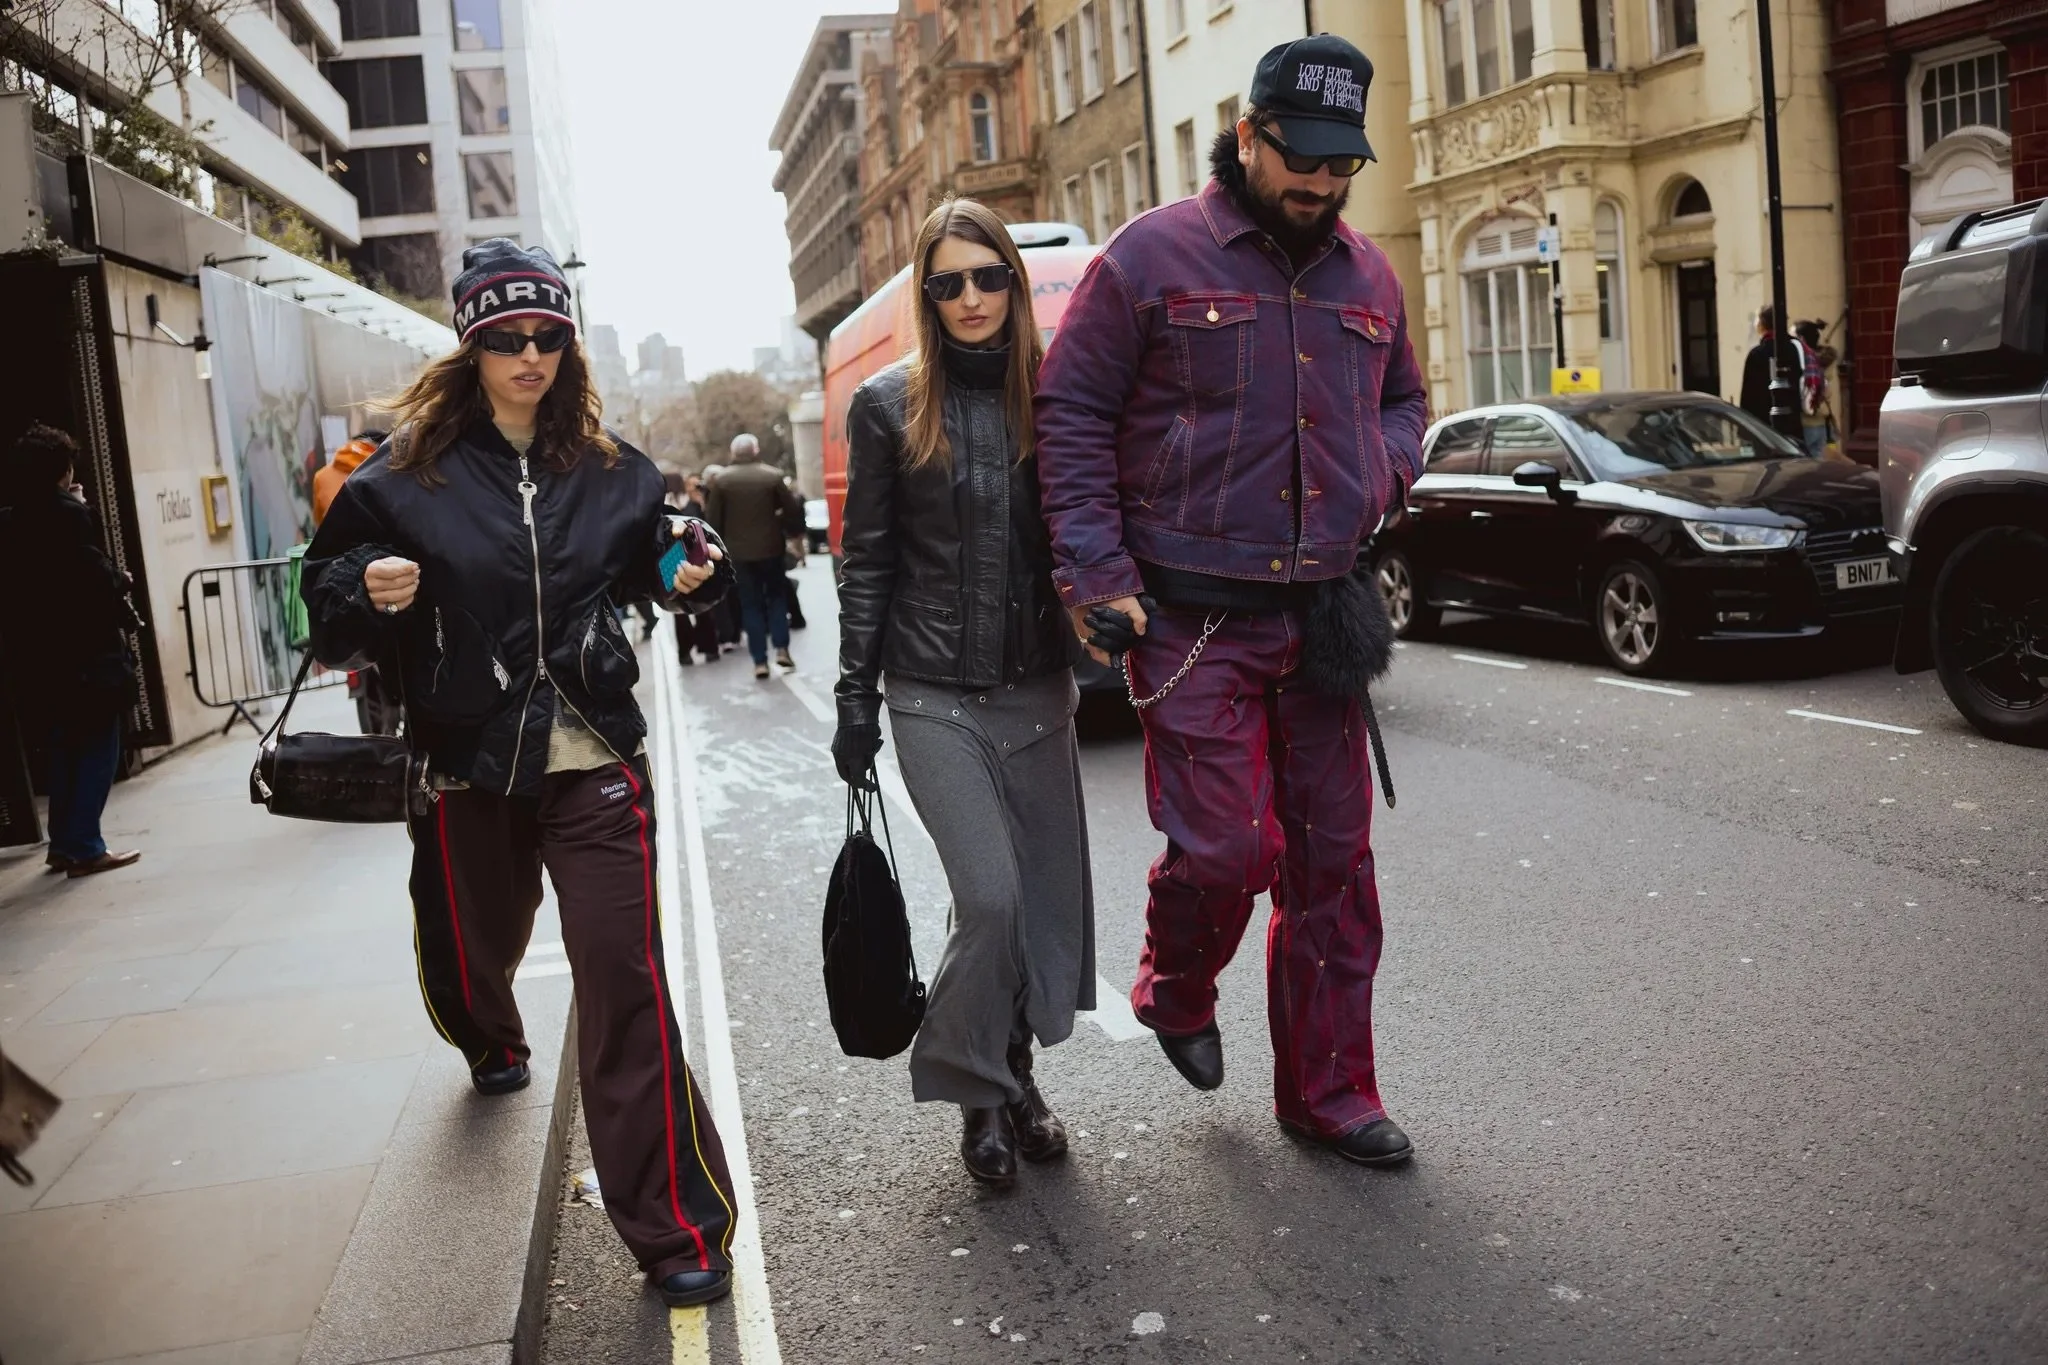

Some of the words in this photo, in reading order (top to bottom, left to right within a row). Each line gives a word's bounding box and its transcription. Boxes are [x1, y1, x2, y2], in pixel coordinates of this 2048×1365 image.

[1298, 63, 1324, 80] LOVE
[1325, 66, 1352, 84] HATE
[1296, 76, 1320, 91] AND
[1322, 92, 1335, 106] IN
[1847, 562, 1881, 584] BN17
[600, 782, 627, 795] Martine
[609, 790, 625, 800] rose
